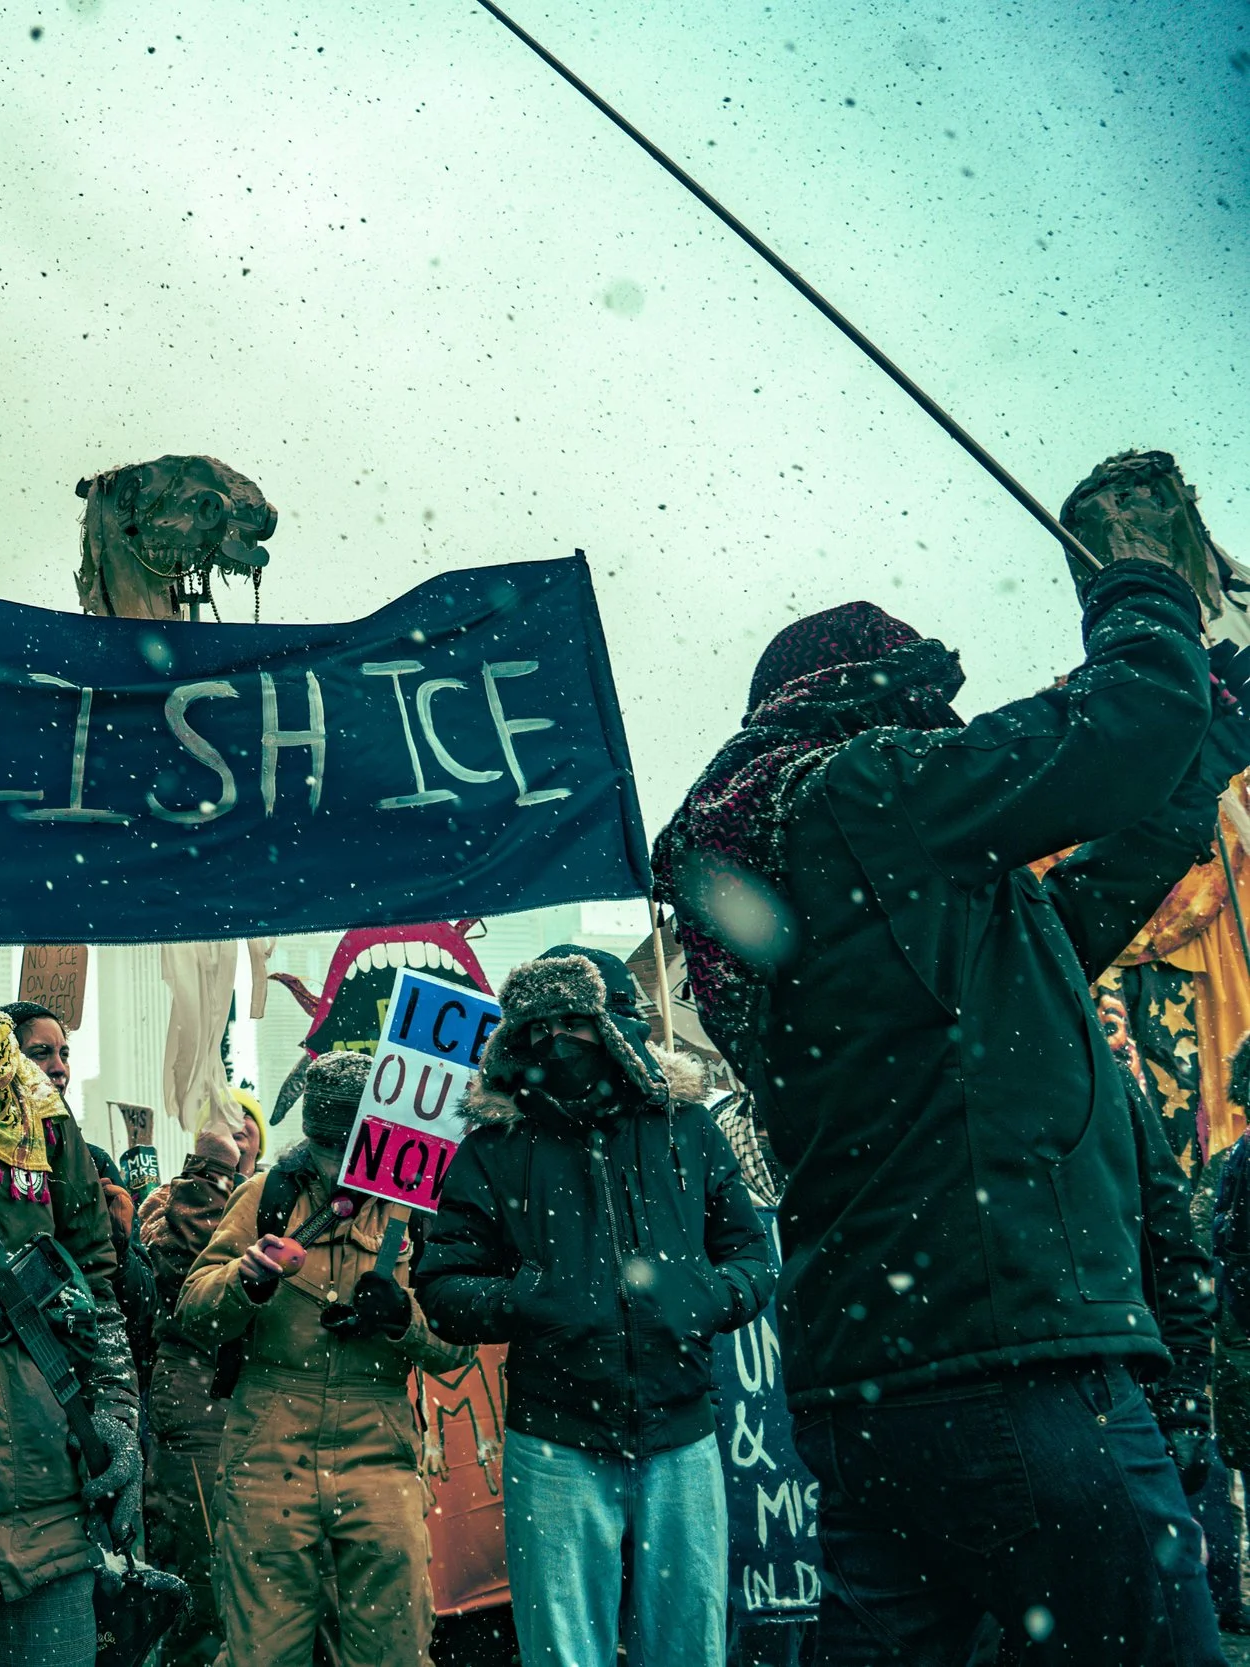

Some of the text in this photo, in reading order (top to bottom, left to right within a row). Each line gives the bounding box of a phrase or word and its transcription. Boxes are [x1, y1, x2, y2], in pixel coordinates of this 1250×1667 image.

[360, 660, 573, 809] ICE
[27, 946, 78, 969] NO ICE
[27, 972, 78, 994] ON OUR
[398, 987, 502, 1065] ICE
[373, 1054, 474, 1136] OU
[732, 1401, 777, 1470] &
